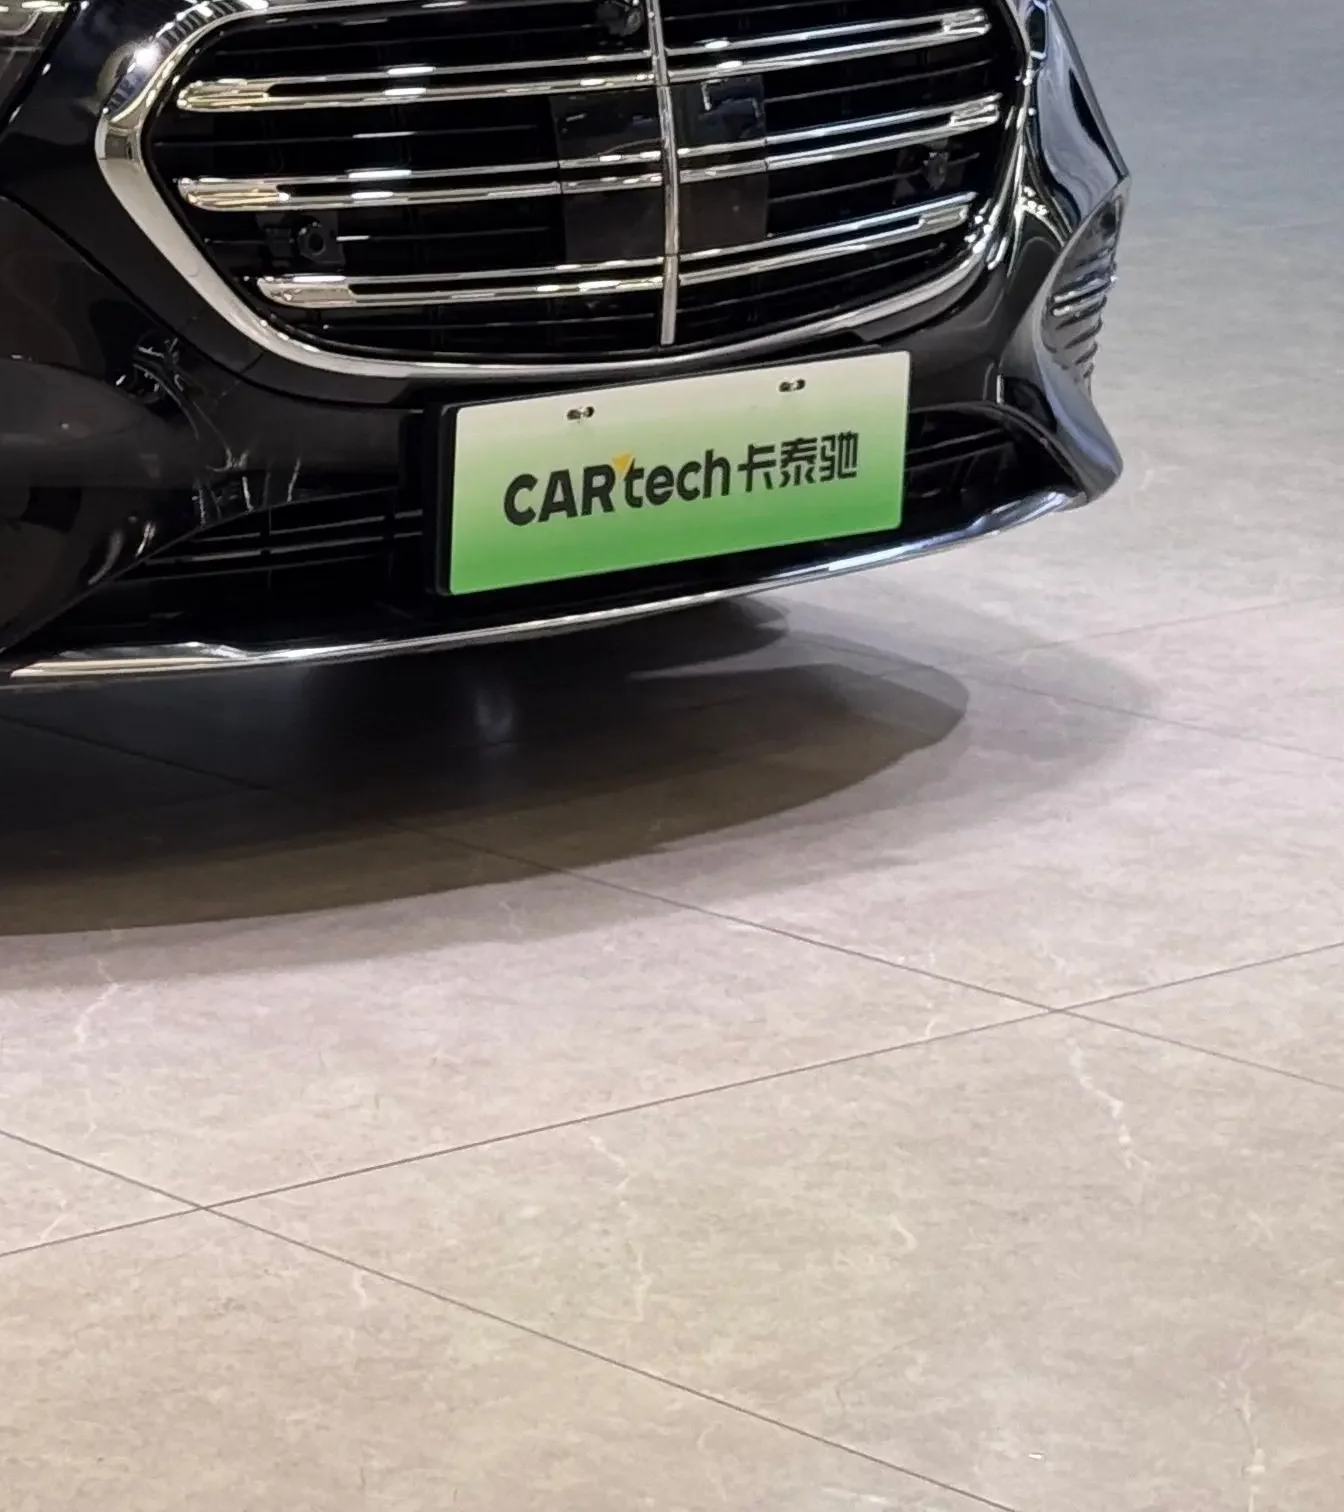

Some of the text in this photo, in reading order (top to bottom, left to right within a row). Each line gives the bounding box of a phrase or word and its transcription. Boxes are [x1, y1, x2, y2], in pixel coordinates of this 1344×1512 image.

[503, 431, 859, 526] CARtech 卡泰驰
